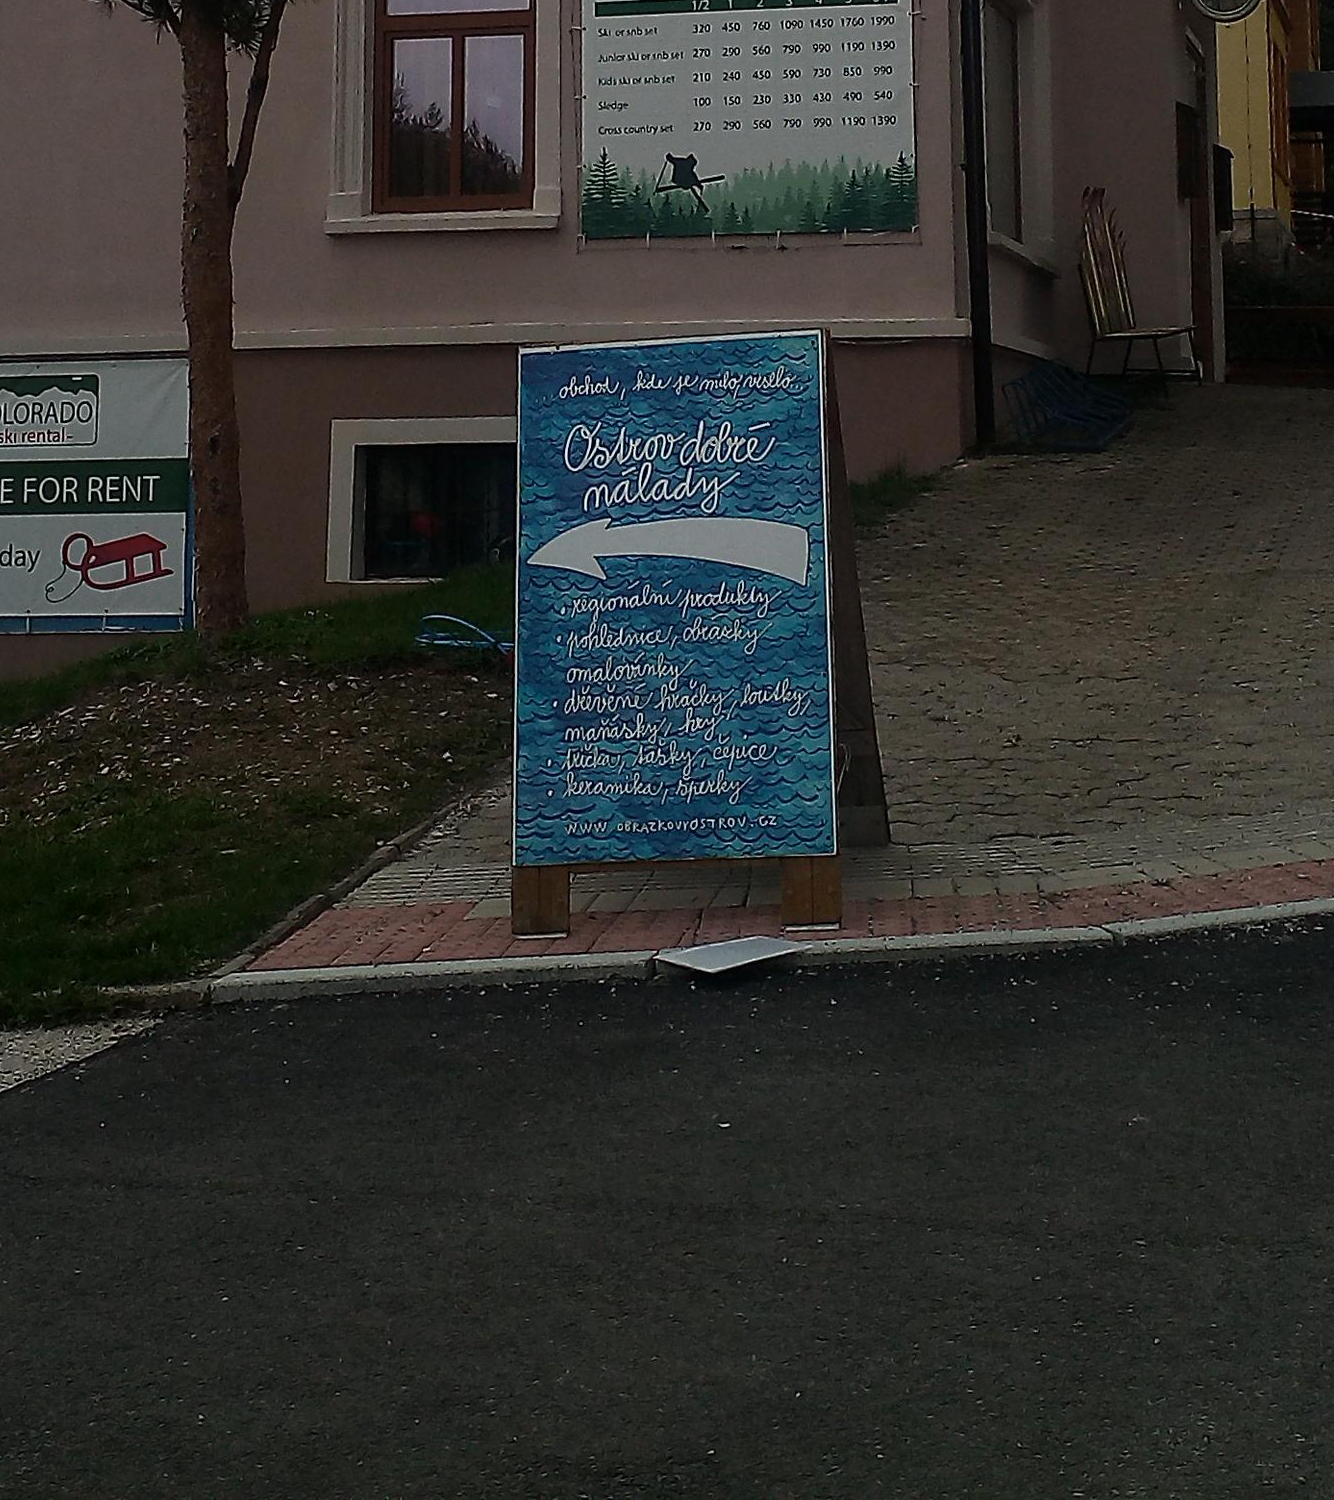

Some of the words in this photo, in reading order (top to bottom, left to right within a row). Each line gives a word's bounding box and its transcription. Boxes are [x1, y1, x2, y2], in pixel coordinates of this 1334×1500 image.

[692, 0, 710, 11] 1/2
[615, 29, 625, 37] or
[692, 24, 711, 34] 320
[722, 22, 741, 32] 450
[752, 21, 771, 31] 760
[780, 20, 804, 30] 1090
[810, 18, 834, 28] 1450
[840, 17, 865, 27] 1760
[871, 16, 895, 26] 1990
[641, 53, 651, 61] or
[692, 48, 711, 58] 270
[722, 47, 741, 57] 290
[752, 45, 771, 56] 560
[782, 44, 802, 54] 790
[812, 43, 832, 53] 990
[841, 42, 865, 52] 1190
[871, 40, 896, 50] 1390
[692, 73, 711, 83] 210
[722, 71, 741, 81] 240
[752, 70, 771, 80] 450
[782, 69, 802, 79] 590
[813, 68, 832, 78] 730
[843, 67, 862, 77] 850
[873, 65, 893, 75] 990
[598, 100, 629, 112] Sledge
[693, 97, 712, 107] 100
[723, 96, 741, 106] 150
[752, 95, 772, 105] 230
[783, 93, 802, 103] 330
[813, 92, 832, 102] 430
[842, 91, 863, 101] 490
[873, 90, 893, 100] 540
[598, 126, 622, 135] Cross
[624, 124, 659, 136] country
[693, 122, 712, 132] 270
[722, 120, 741, 130] 290
[752, 119, 772, 129] 560
[783, 118, 802, 128] 790
[813, 117, 833, 127] 990
[841, 116, 866, 126] 1190
[871, 115, 897, 125] 1390
[632, 369, 672, 392] kde
[673, 374, 699, 396] je
[565, 421, 686, 472] Ostrov
[679, 419, 776, 466] dobré
[23, 477, 78, 504] FOR
[87, 475, 161, 503] RENT
[584, 462, 741, 513] nálady
[570, 579, 683, 621] regionální
[679, 580, 782, 617] produkty
[682, 612, 773, 655] obrázky
[566, 652, 696, 690] omalovánky
[564, 683, 654, 715] dřevěné
[679, 707, 725, 741] hry
[713, 733, 778, 770] čepice
[675, 769, 753, 805] šperky
